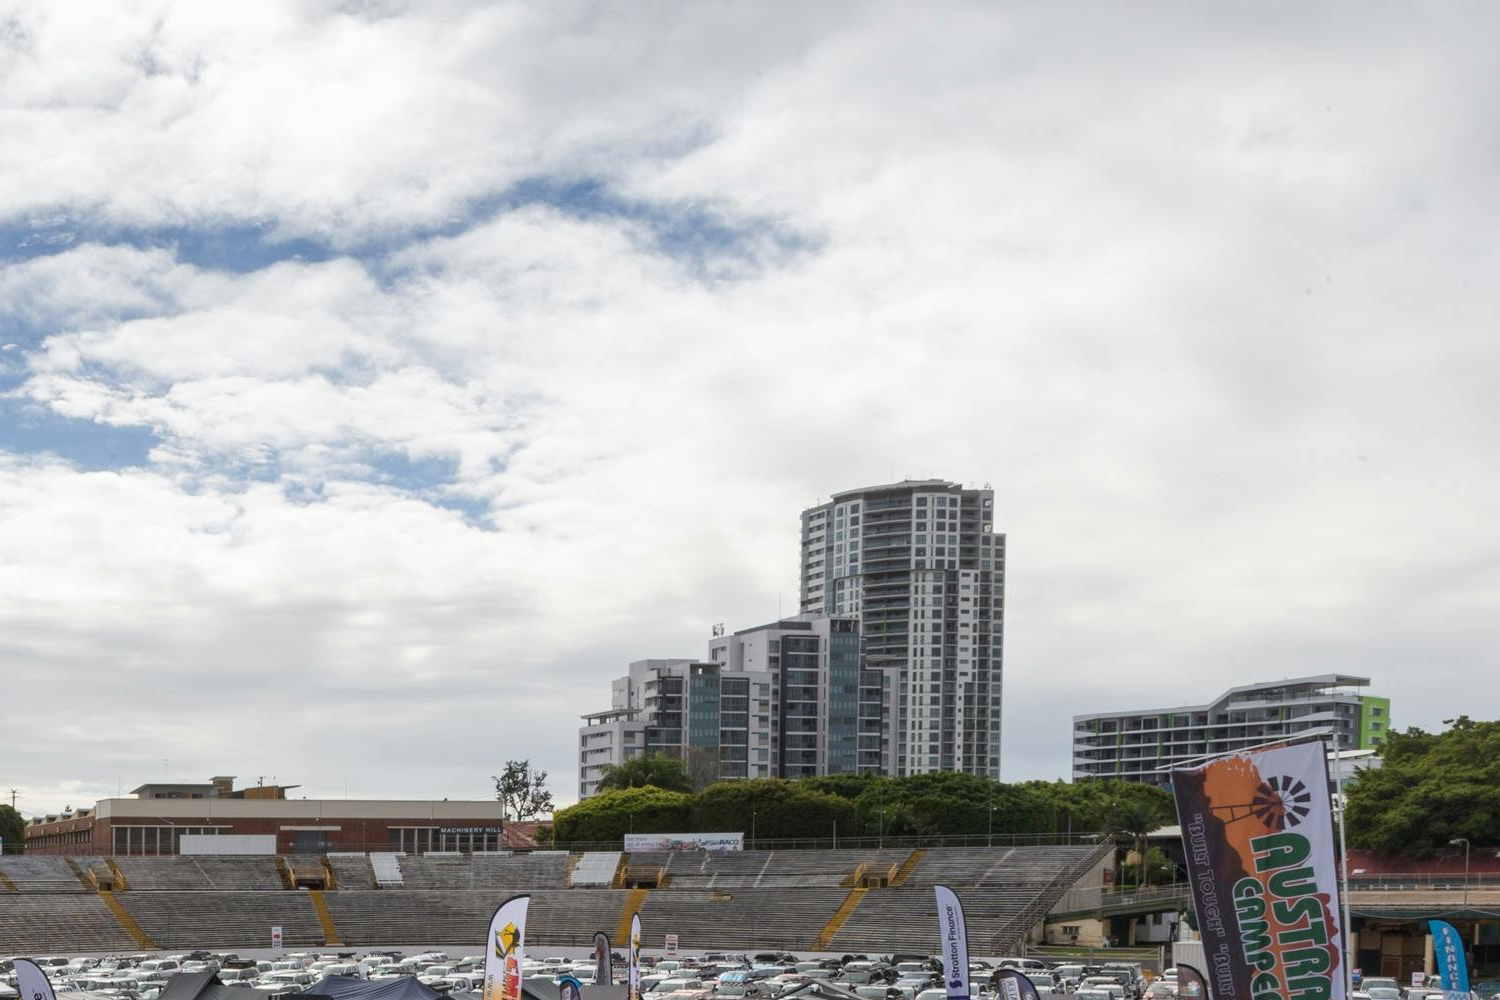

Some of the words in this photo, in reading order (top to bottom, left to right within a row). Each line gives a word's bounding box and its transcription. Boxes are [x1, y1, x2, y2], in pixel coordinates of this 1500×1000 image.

[947, 905, 957, 942] Finance
[949, 942, 961, 979] Stratton
[1443, 927, 1458, 990] FINANCE
